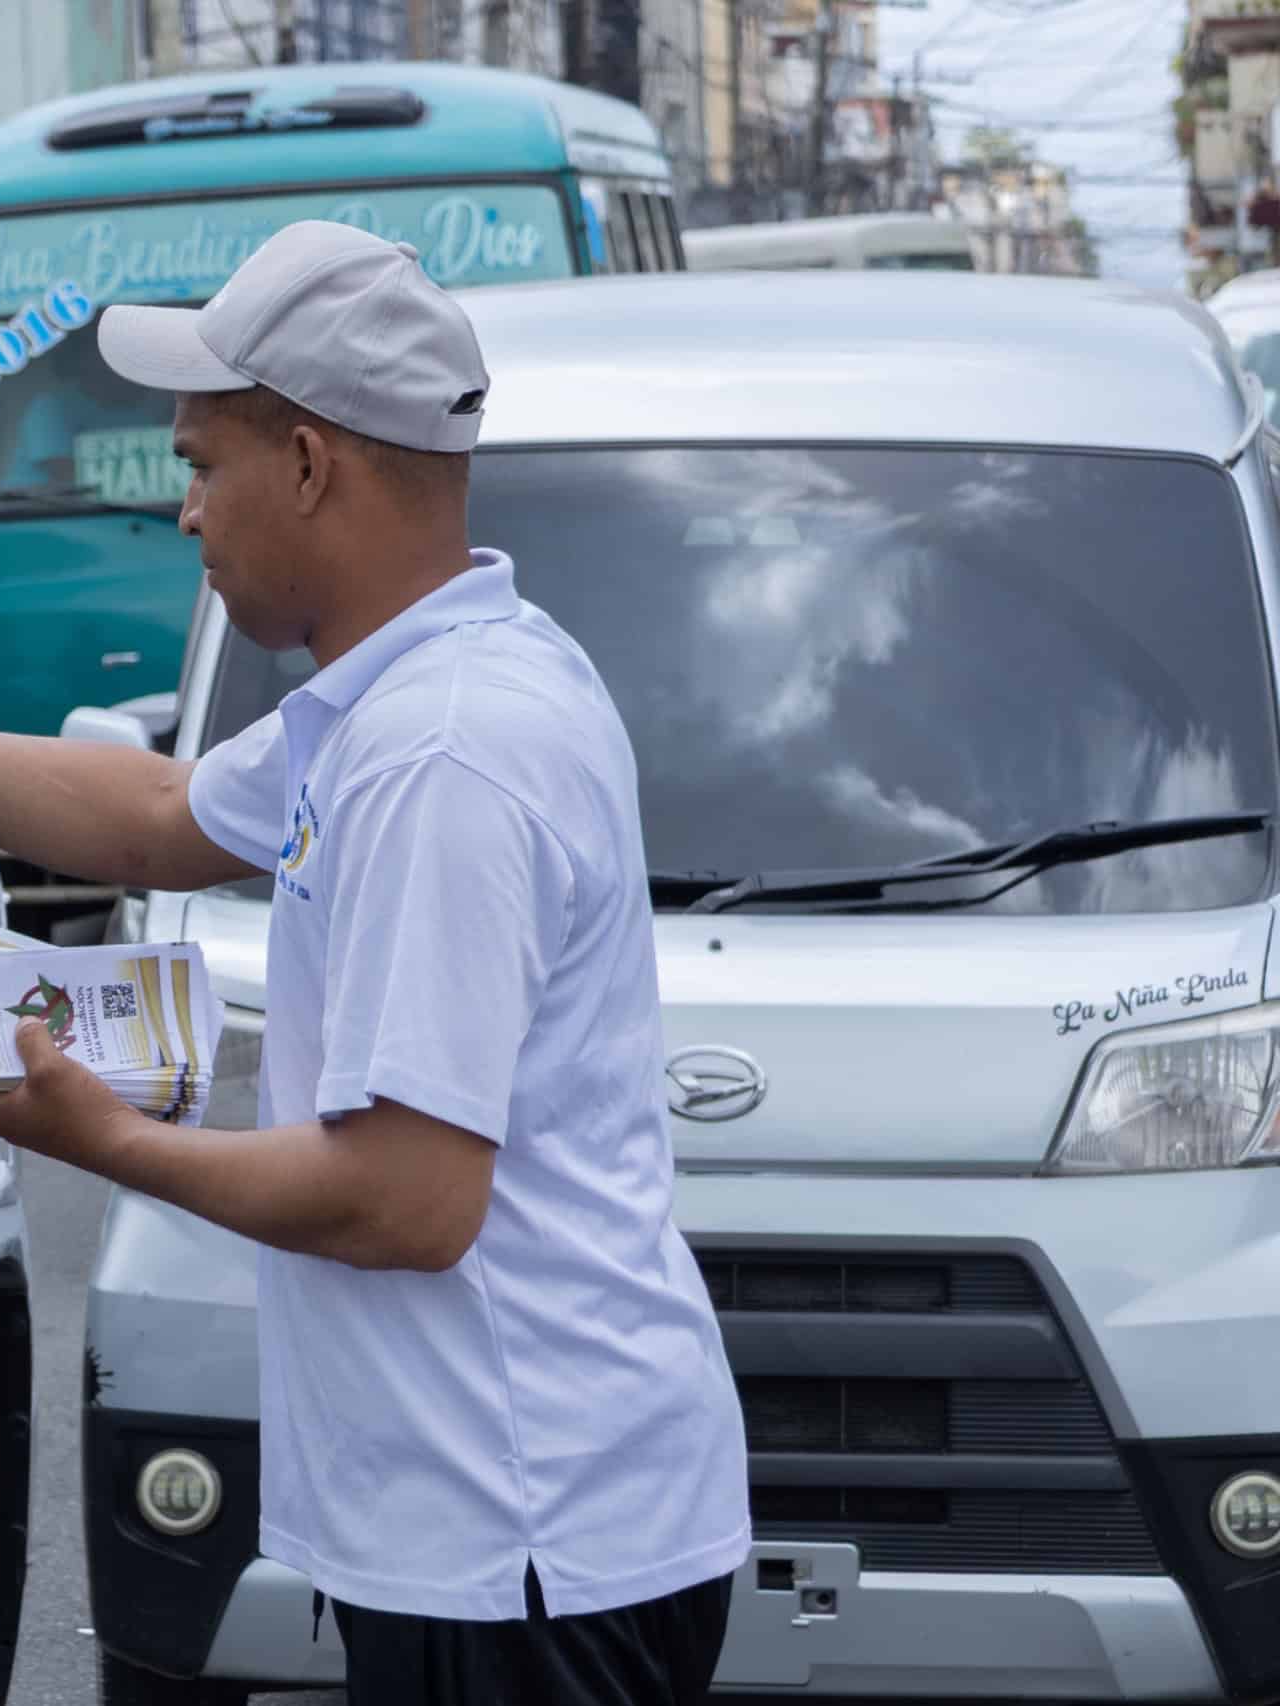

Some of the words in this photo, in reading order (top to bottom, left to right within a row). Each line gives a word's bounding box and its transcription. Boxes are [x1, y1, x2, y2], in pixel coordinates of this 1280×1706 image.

[63, 213, 260, 300] Bendici
[423, 196, 542, 278] Dios
[78, 449, 193, 502] HAIN
[1052, 1000, 1095, 1036] La
[1103, 985, 1168, 1022] Niña
[1175, 967, 1249, 1006] Linda
